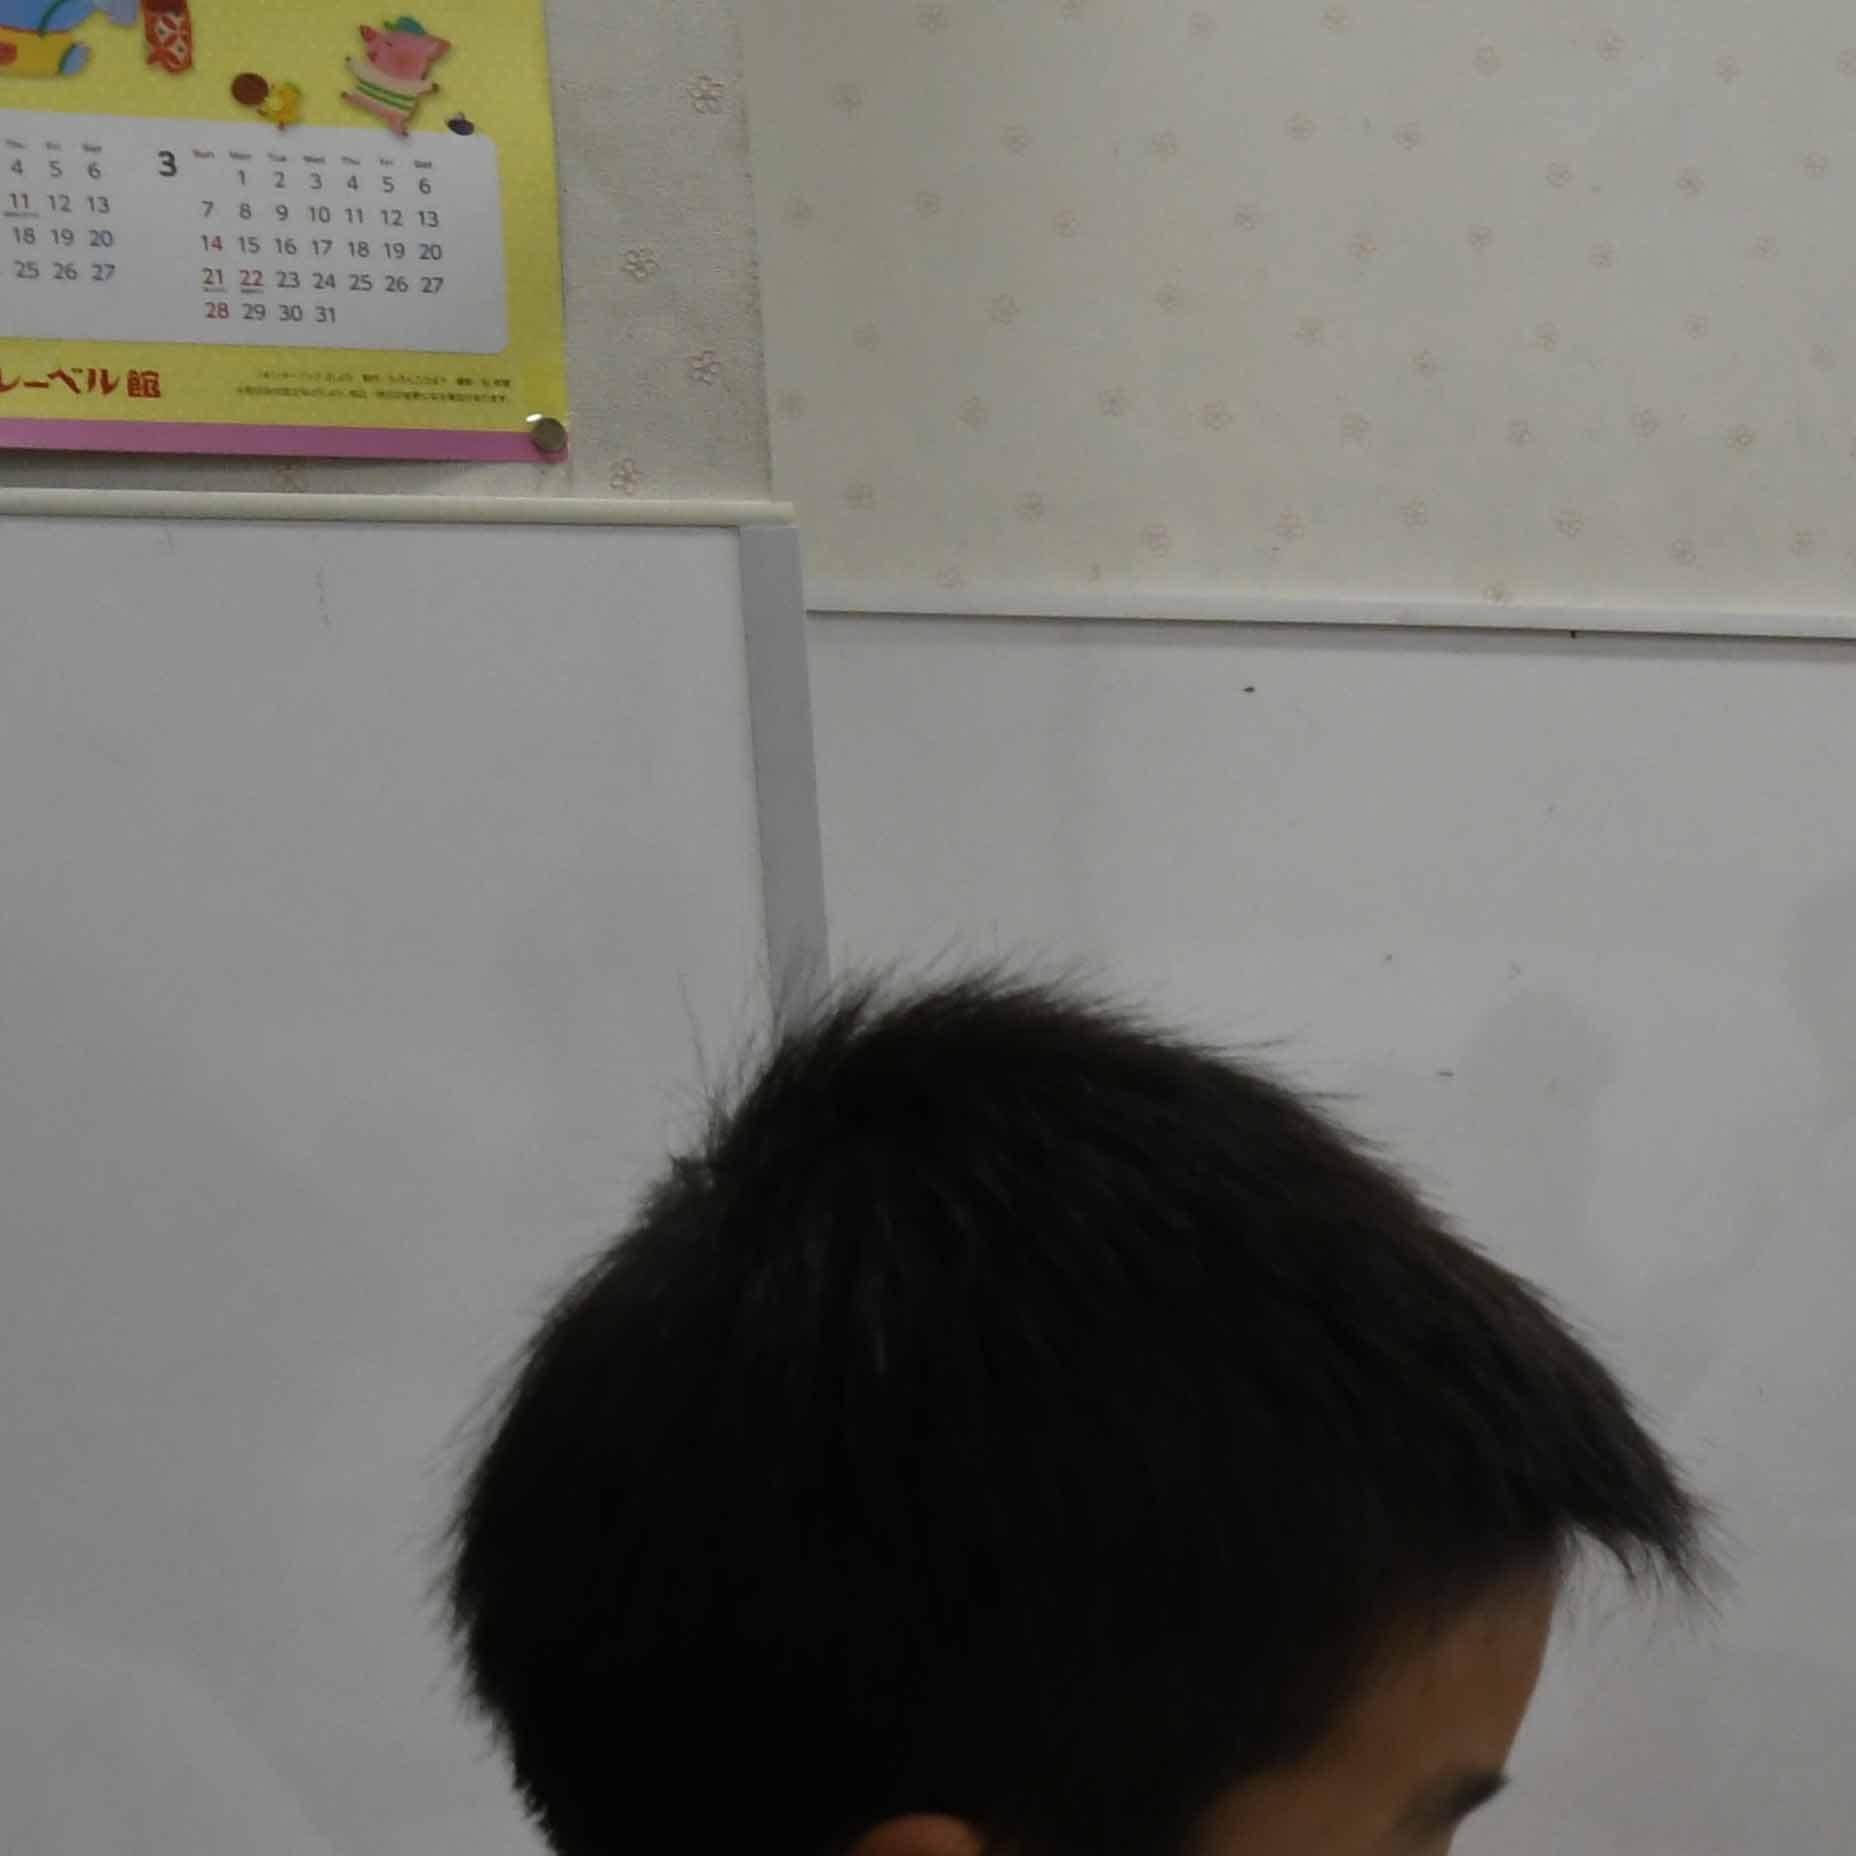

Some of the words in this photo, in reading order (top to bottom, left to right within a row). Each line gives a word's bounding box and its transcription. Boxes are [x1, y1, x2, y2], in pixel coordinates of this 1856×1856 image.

[10, 159, 23, 176] 4
[50, 160, 63, 178] 5
[88, 161, 101, 179] 6
[158, 151, 177, 177] 3
[238, 170, 246, 186] 1
[274, 171, 285, 189] 2
[310, 173, 322, 190] 3
[346, 175, 358, 190] 4
[383, 176, 395, 193] 5
[419, 177, 431, 194] 6
[9, 192, 29, 209] 11
[48, 193, 72, 213] 12
[87, 195, 110, 214] 13
[201, 200, 214, 217] 7
[239, 203, 252, 220] 8
[275, 204, 288, 221] 9
[309, 206, 331, 223] 10
[345, 208, 364, 224] 11
[381, 209, 403, 227] 12
[418, 210, 439, 228] 13
[13, 227, 36, 245] 18
[51, 228, 74, 246] 19
[89, 229, 113, 247] 20
[201, 235, 223, 252] 14
[238, 236, 260, 254] 15
[274, 238, 297, 255] 16
[312, 239, 333, 256] 17
[348, 241, 370, 258] 18
[384, 242, 405, 259] 19
[419, 244, 442, 261] 20
[14, 260, 39, 279] 25
[52, 261, 78, 281] 26
[91, 263, 116, 281] 27
[202, 268, 223, 286] 21
[239, 269, 263, 287] 22
[275, 271, 300, 288] 23
[312, 272, 336, 290] 24
[349, 274, 373, 291] 25
[385, 275, 408, 293] 26
[421, 276, 444, 294] 27
[205, 301, 229, 319] 28
[242, 303, 266, 321] 29
[279, 304, 303, 322] 30
[315, 306, 336, 323] 31
